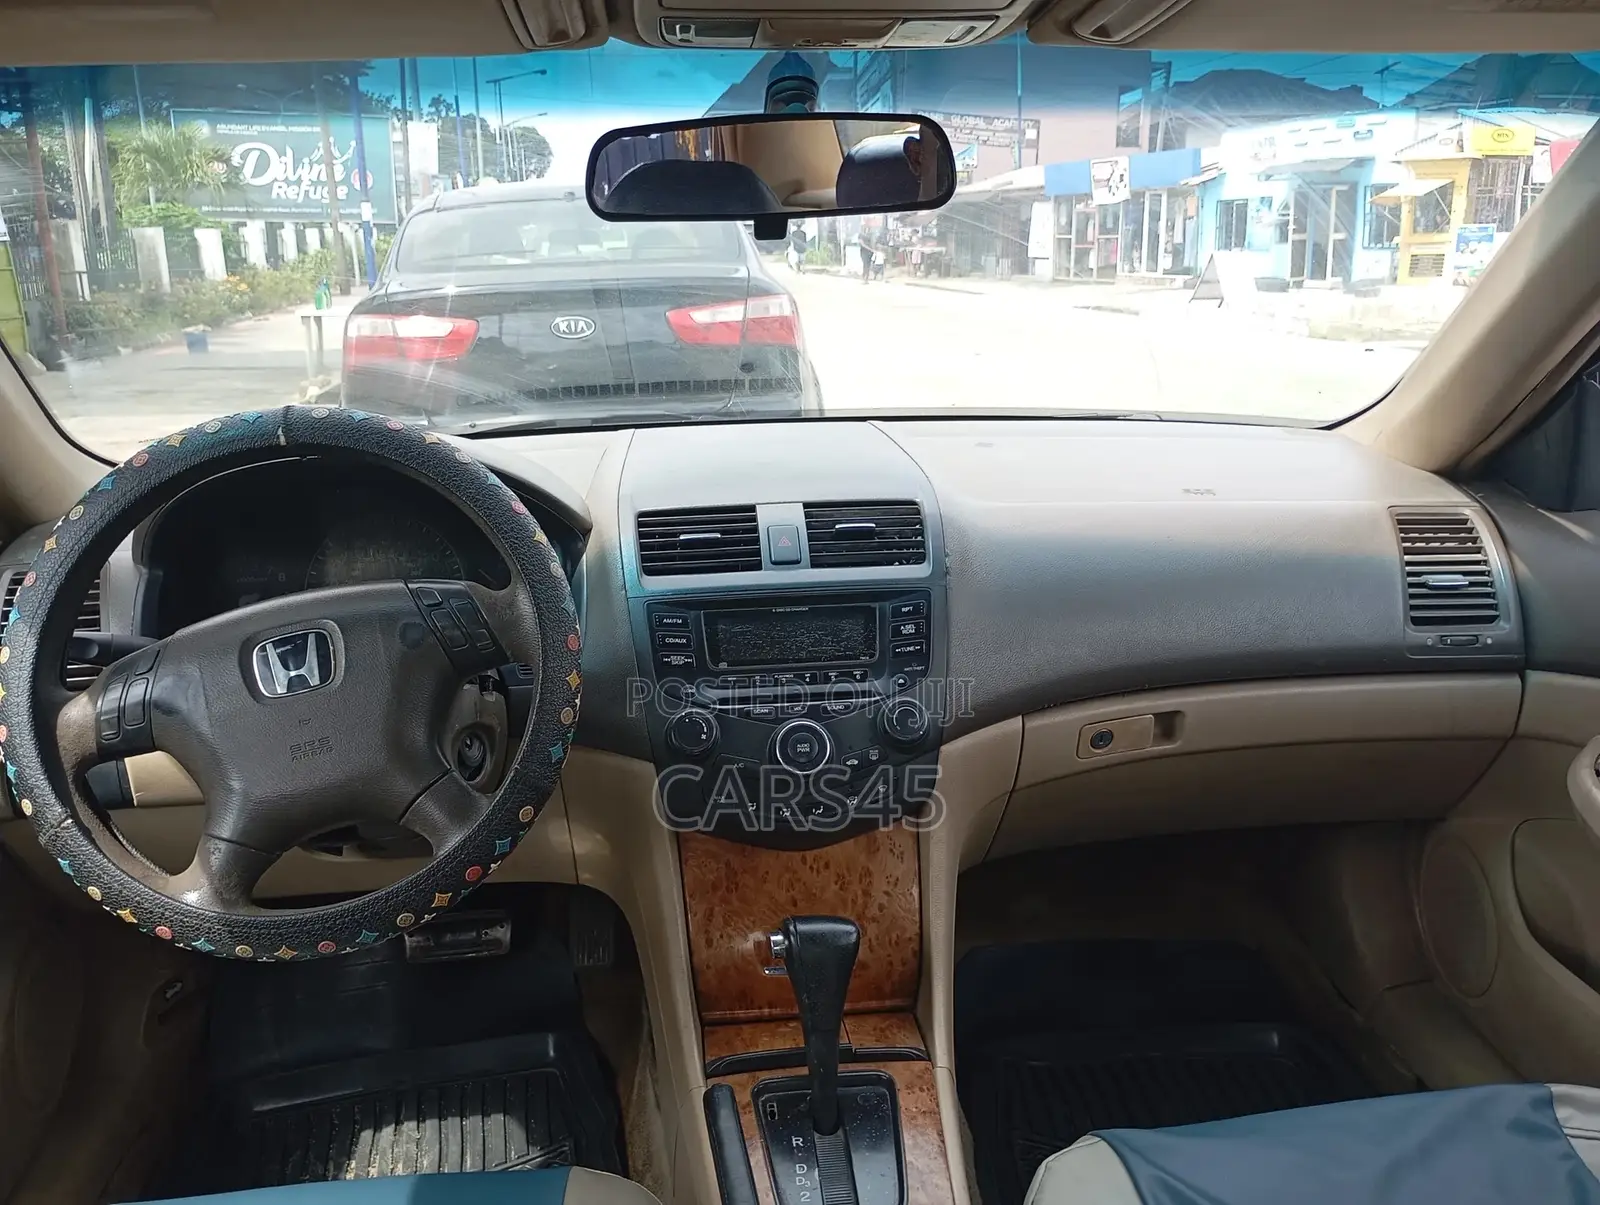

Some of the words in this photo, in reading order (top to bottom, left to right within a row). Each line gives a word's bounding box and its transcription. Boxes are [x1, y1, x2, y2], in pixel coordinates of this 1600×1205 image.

[558, 319, 588, 333] KIA
[791, 1136, 803, 1147] R
[796, 1164, 807, 1174] D
[800, 1191, 811, 1202] 2
